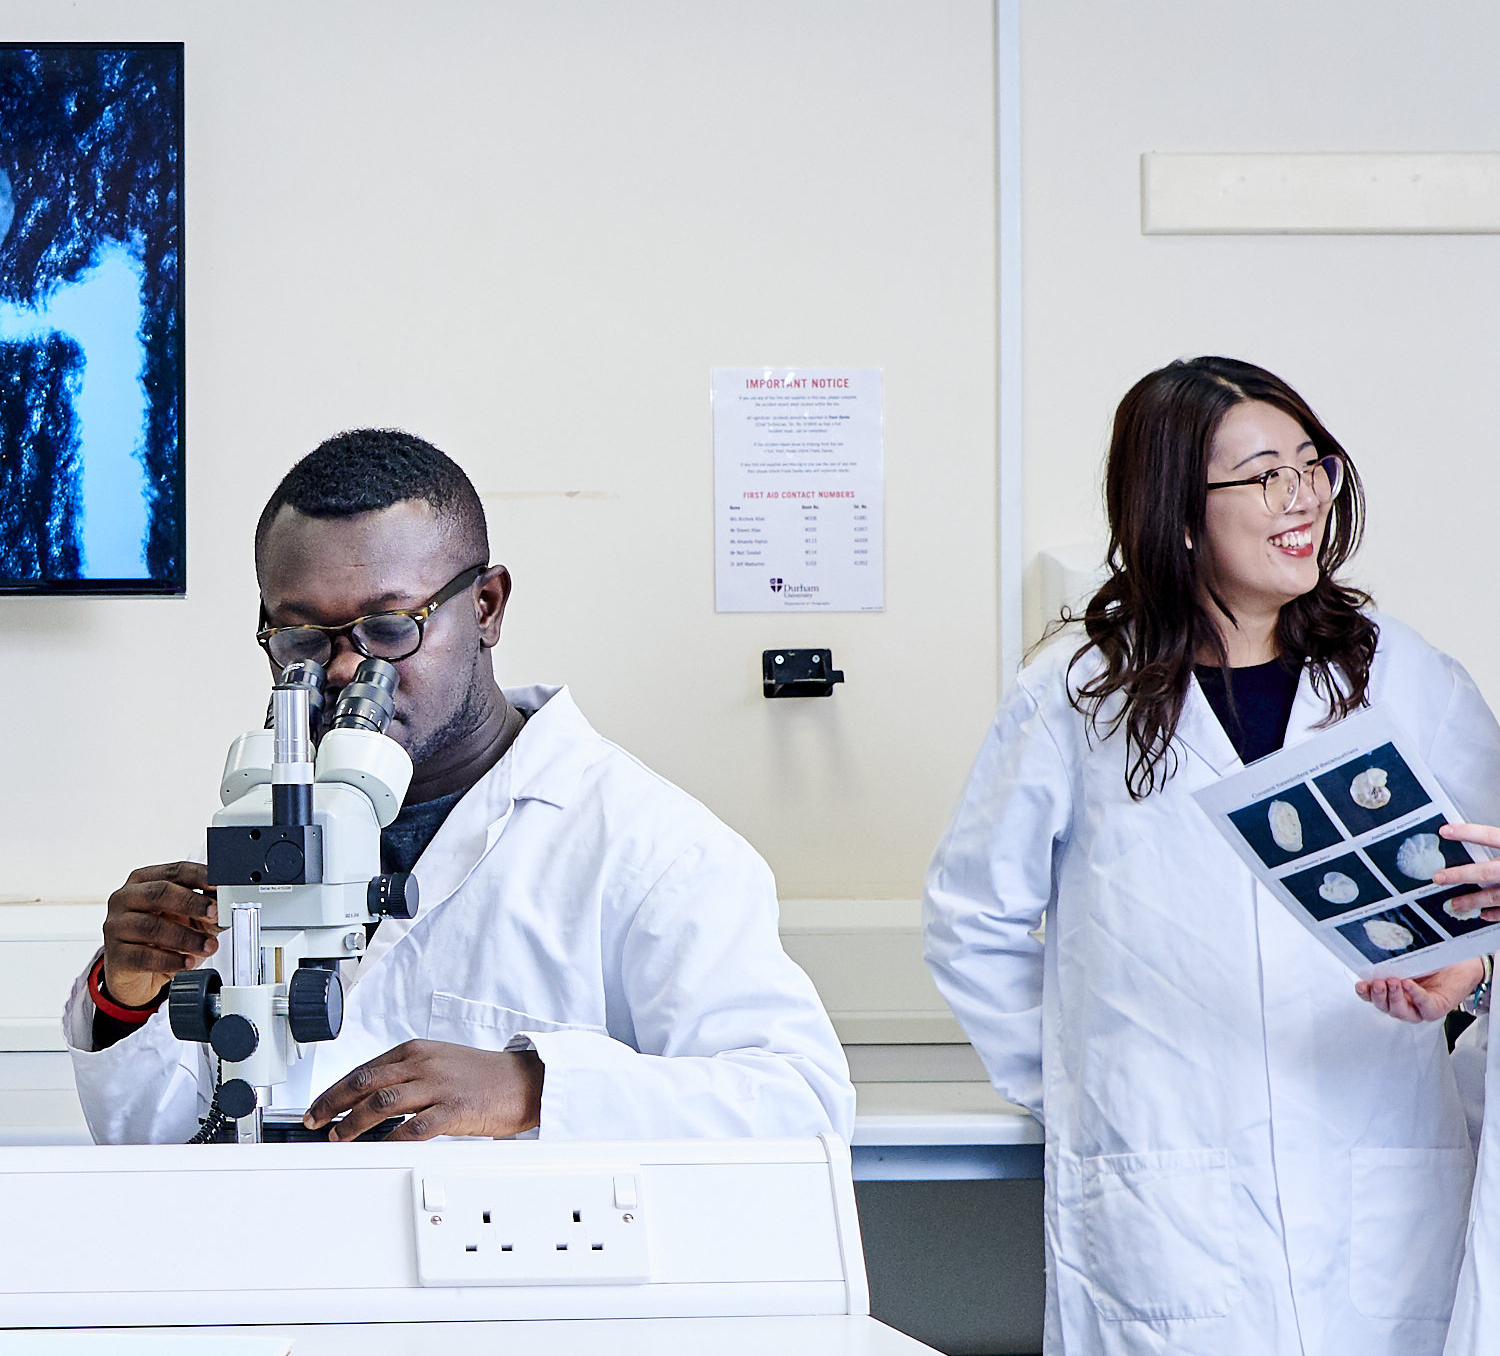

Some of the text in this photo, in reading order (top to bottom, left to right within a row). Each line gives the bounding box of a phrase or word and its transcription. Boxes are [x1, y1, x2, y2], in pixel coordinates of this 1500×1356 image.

[746, 378, 849, 388] IMPORTANT NOTICE
[783, 584, 819, 593] Durham
